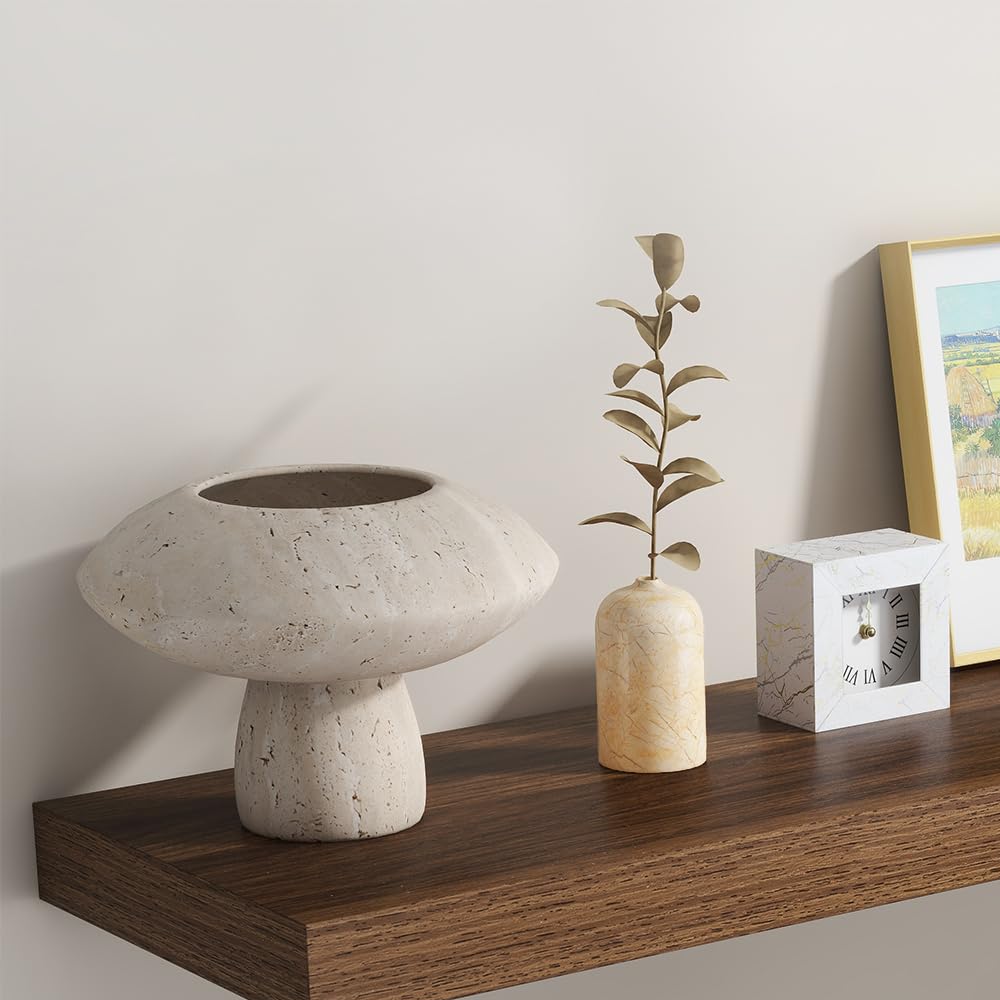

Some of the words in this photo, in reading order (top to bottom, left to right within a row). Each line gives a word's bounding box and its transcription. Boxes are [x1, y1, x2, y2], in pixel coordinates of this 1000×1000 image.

[889, 594, 903, 608] II
[896, 613, 909, 629] III
[882, 660, 893, 675] V
[864, 667, 877, 685] VI
